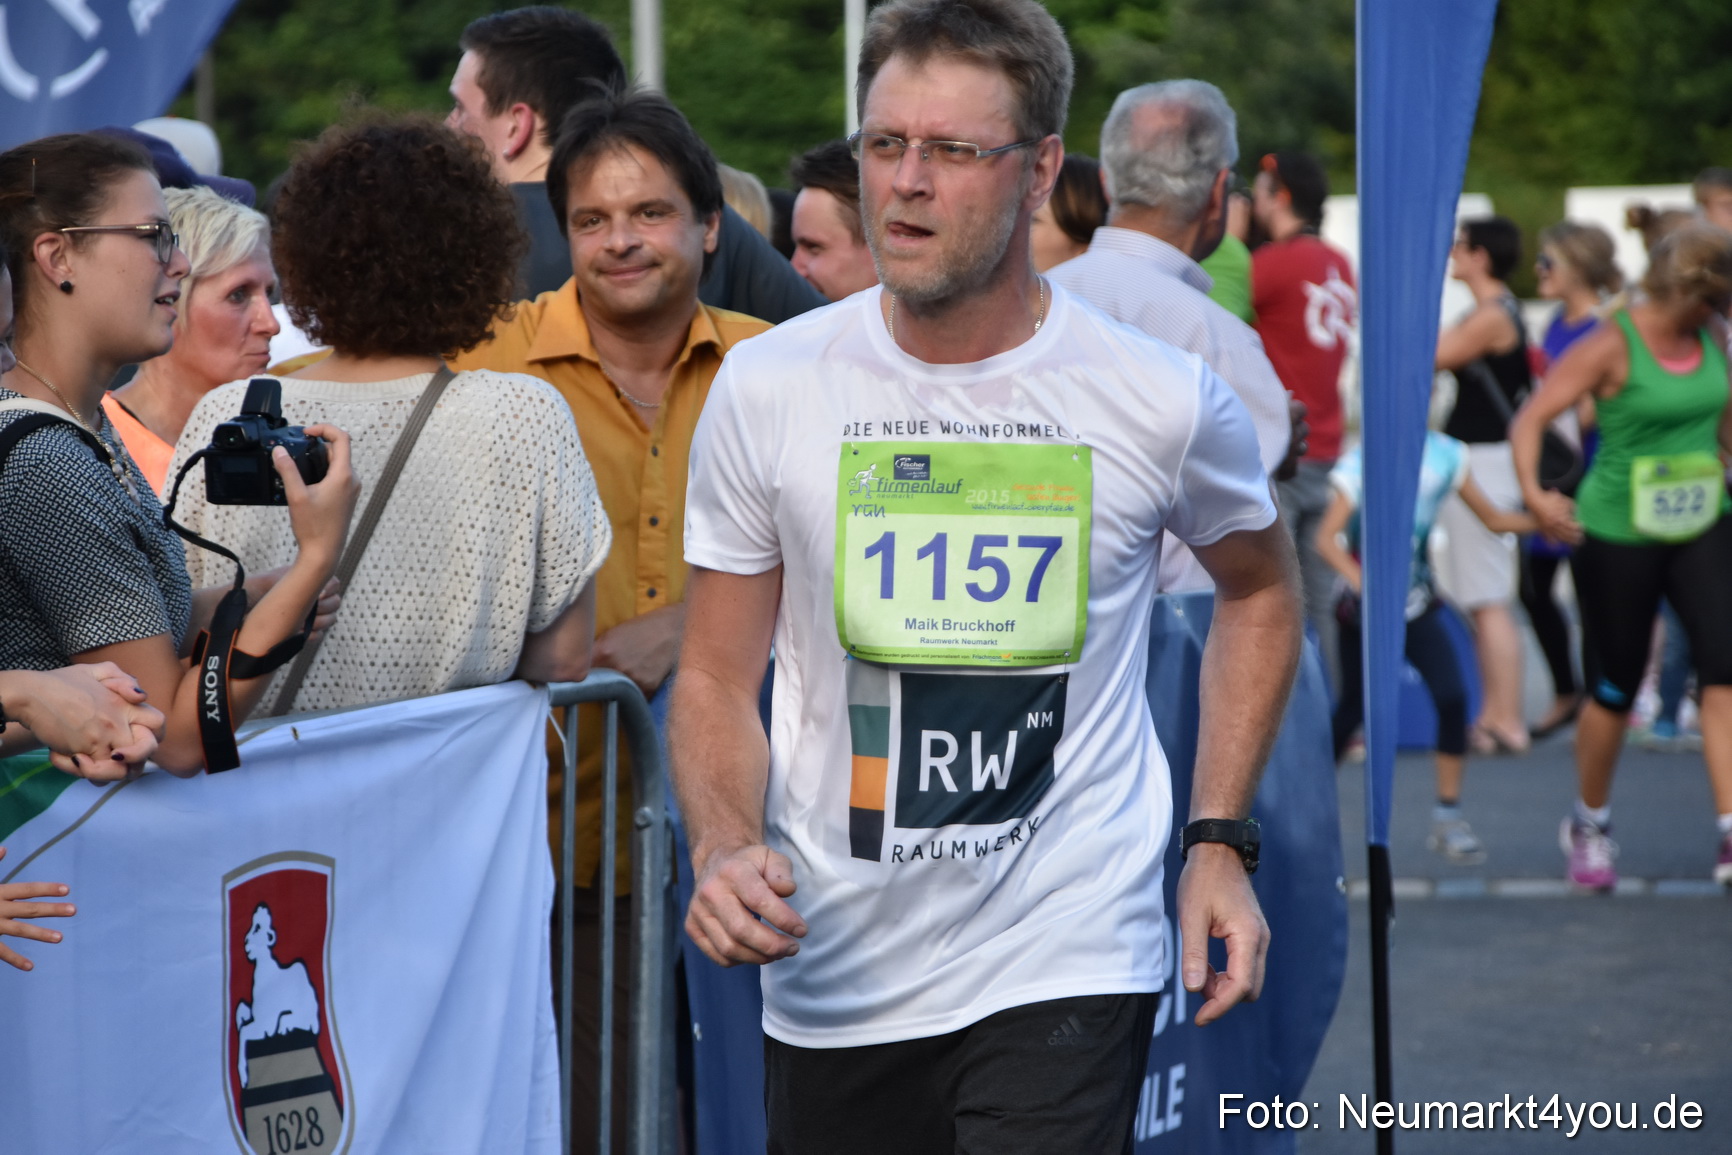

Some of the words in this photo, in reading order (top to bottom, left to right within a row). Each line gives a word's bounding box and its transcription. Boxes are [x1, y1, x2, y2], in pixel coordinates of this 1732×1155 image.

[843, 422, 873, 436] DIE
[883, 420, 930, 435] NEUE
[876, 477, 964, 494] firmenlauf
[965, 489, 1010, 504] 2015
[1654, 484, 1706, 515] 522
[864, 531, 1063, 603] 1157
[904, 617, 939, 630] Maik
[942, 618, 1016, 632] Bruckhoff
[920, 636, 960, 645] Raumwerk
[961, 638, 998, 646] Neumarkt
[204, 655, 221, 722] SONY
[1026, 711, 1053, 728] NM
[919, 729, 1018, 792] RW
[891, 816, 1040, 863] RAUMWERK
[263, 1106, 325, 1155] 1628
